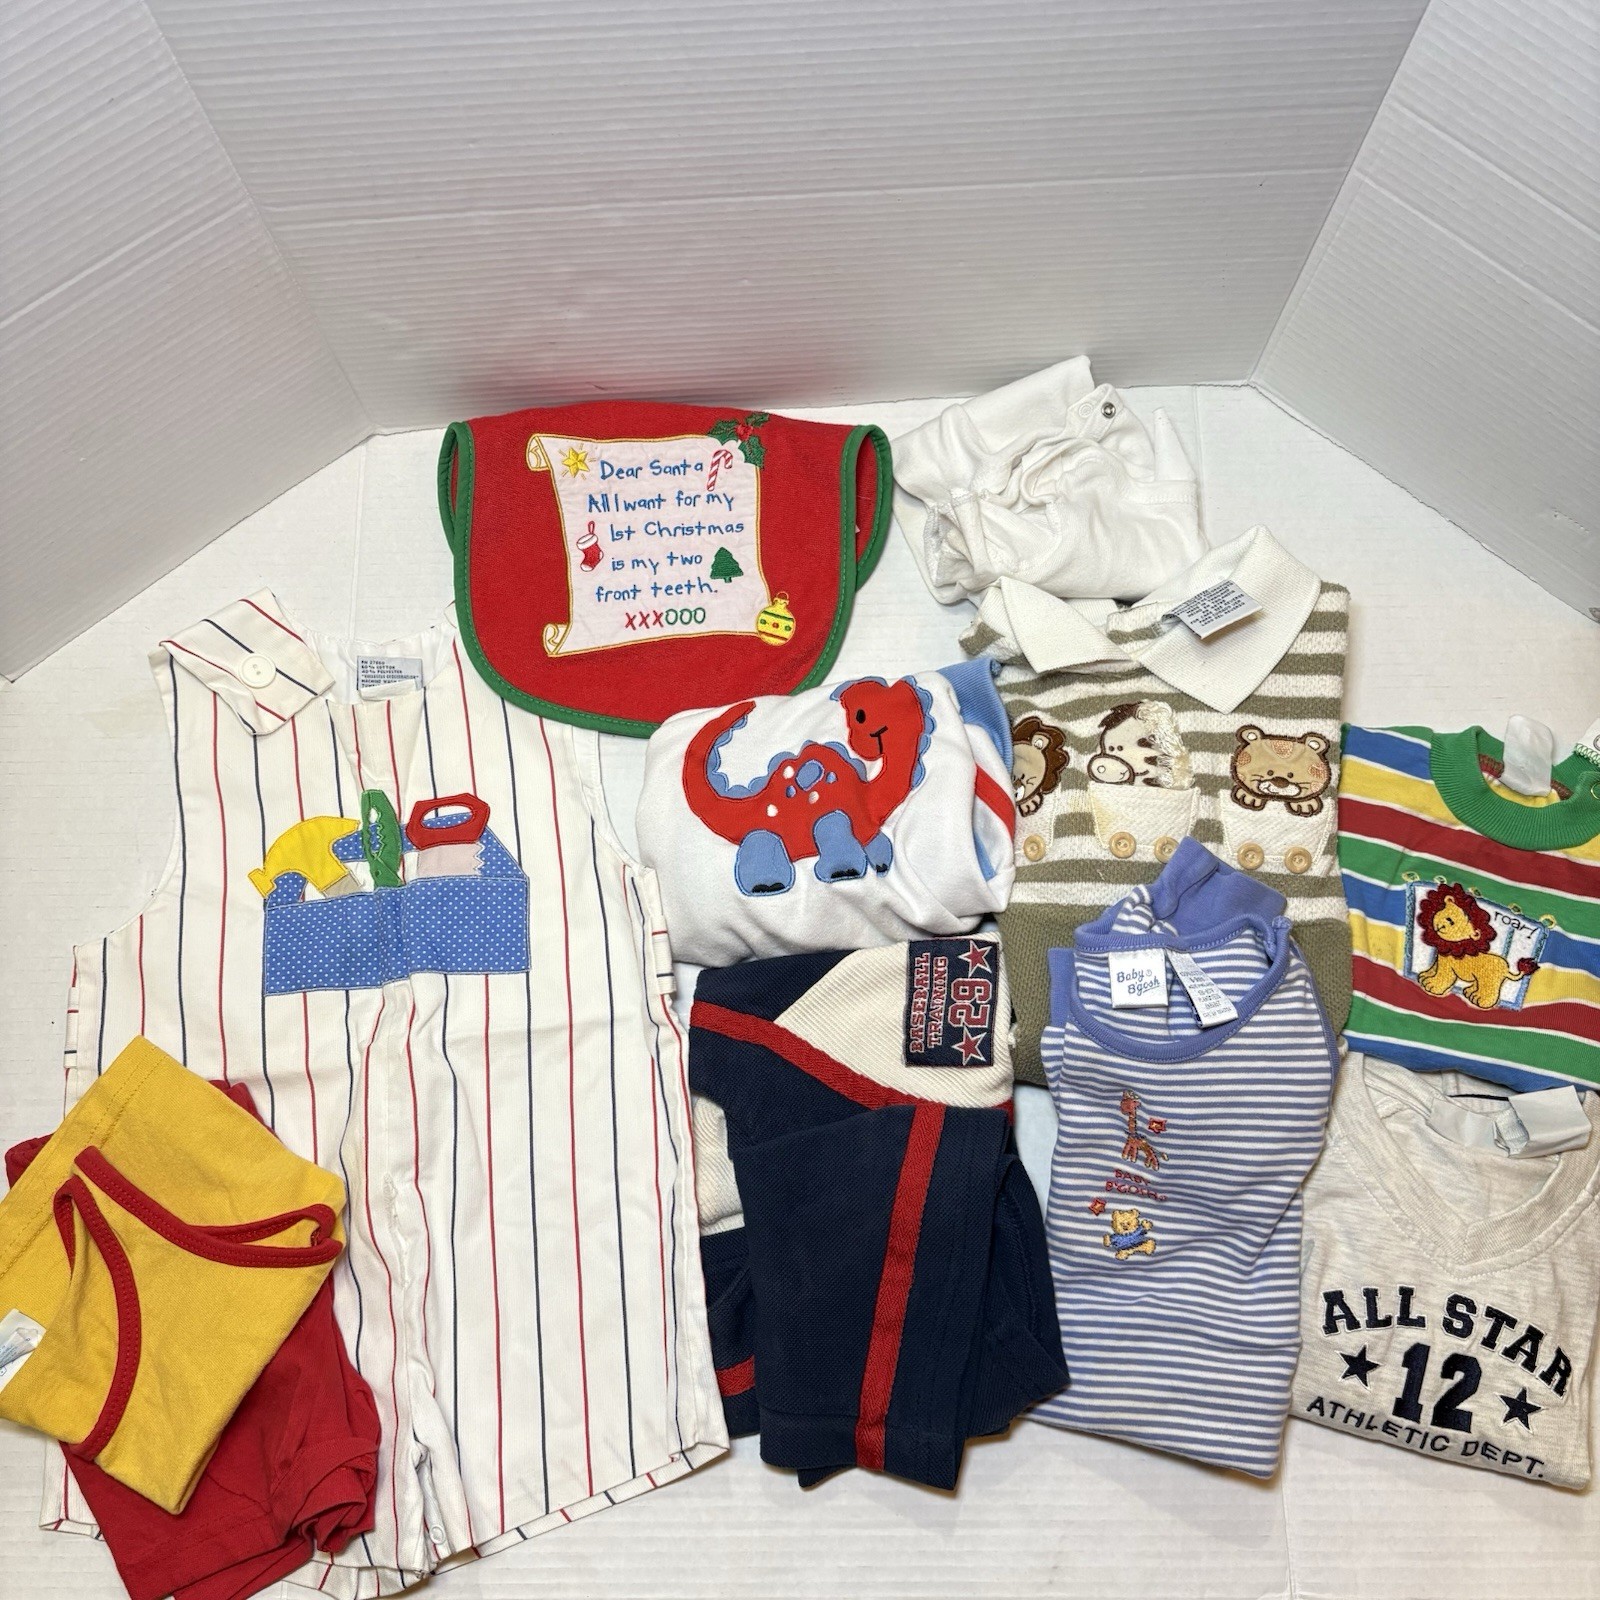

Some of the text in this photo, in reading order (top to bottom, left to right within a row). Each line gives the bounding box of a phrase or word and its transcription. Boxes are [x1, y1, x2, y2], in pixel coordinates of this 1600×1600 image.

[600, 459, 703, 480] Dear Santa
[588, 494, 610, 513] All
[624, 494, 666, 512] want
[676, 491, 701, 508] for
[706, 492, 734, 511] my
[644, 520, 745, 538] Christmas
[611, 552, 703, 575] is my two
[595, 577, 719, 602] front teeth.
[1494, 911, 1539, 939] roar!
[1116, 968, 1145, 983] Baby
[1127, 976, 1160, 996] B'gosh
[910, 952, 931, 1053] BASEBALL
[927, 956, 948, 1048] TRAINING
[948, 978, 992, 1028] 29
[1321, 1286, 1573, 1399] ALL STAR
[1392, 1342, 1482, 1433] 12
[1306, 1396, 1545, 1478] ATHLETIC DEPT.
